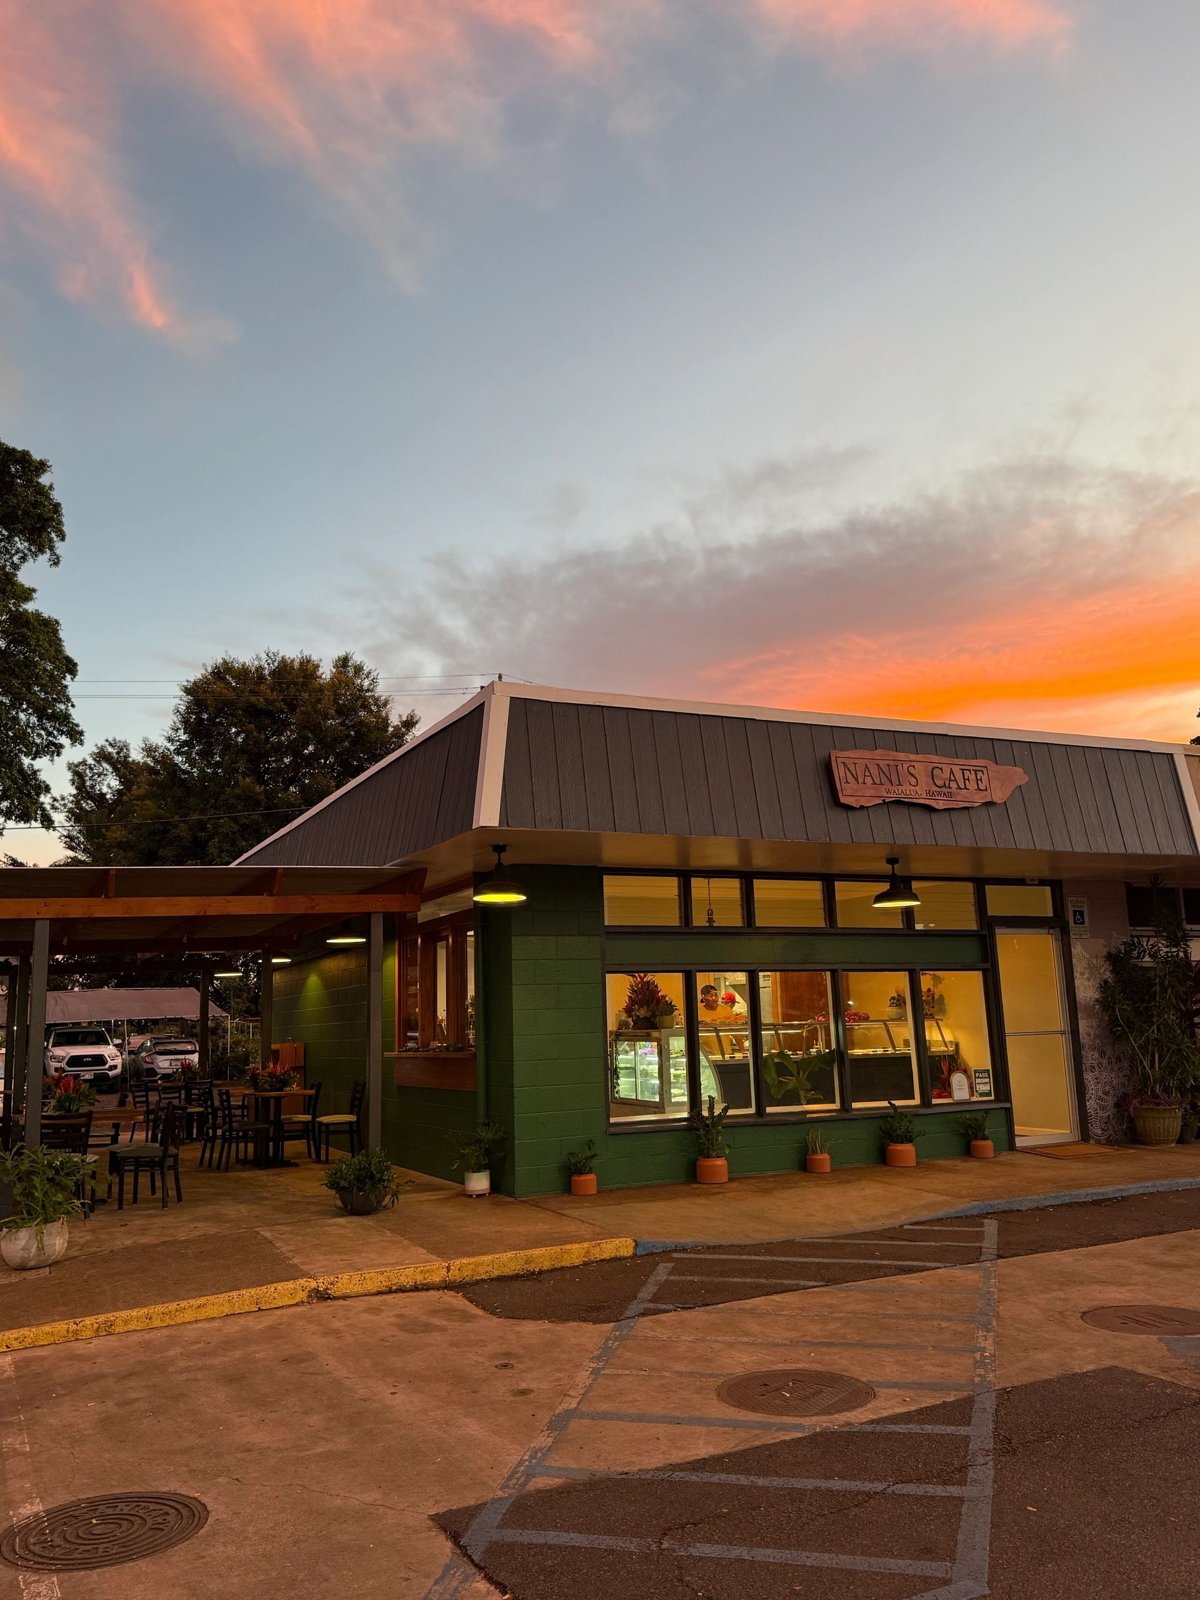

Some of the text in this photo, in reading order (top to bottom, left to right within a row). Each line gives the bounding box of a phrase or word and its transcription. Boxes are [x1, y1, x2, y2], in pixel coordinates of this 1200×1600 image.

[841, 761, 988, 791] NANI'S CAFE
[925, 789, 952, 798] HAWAII
